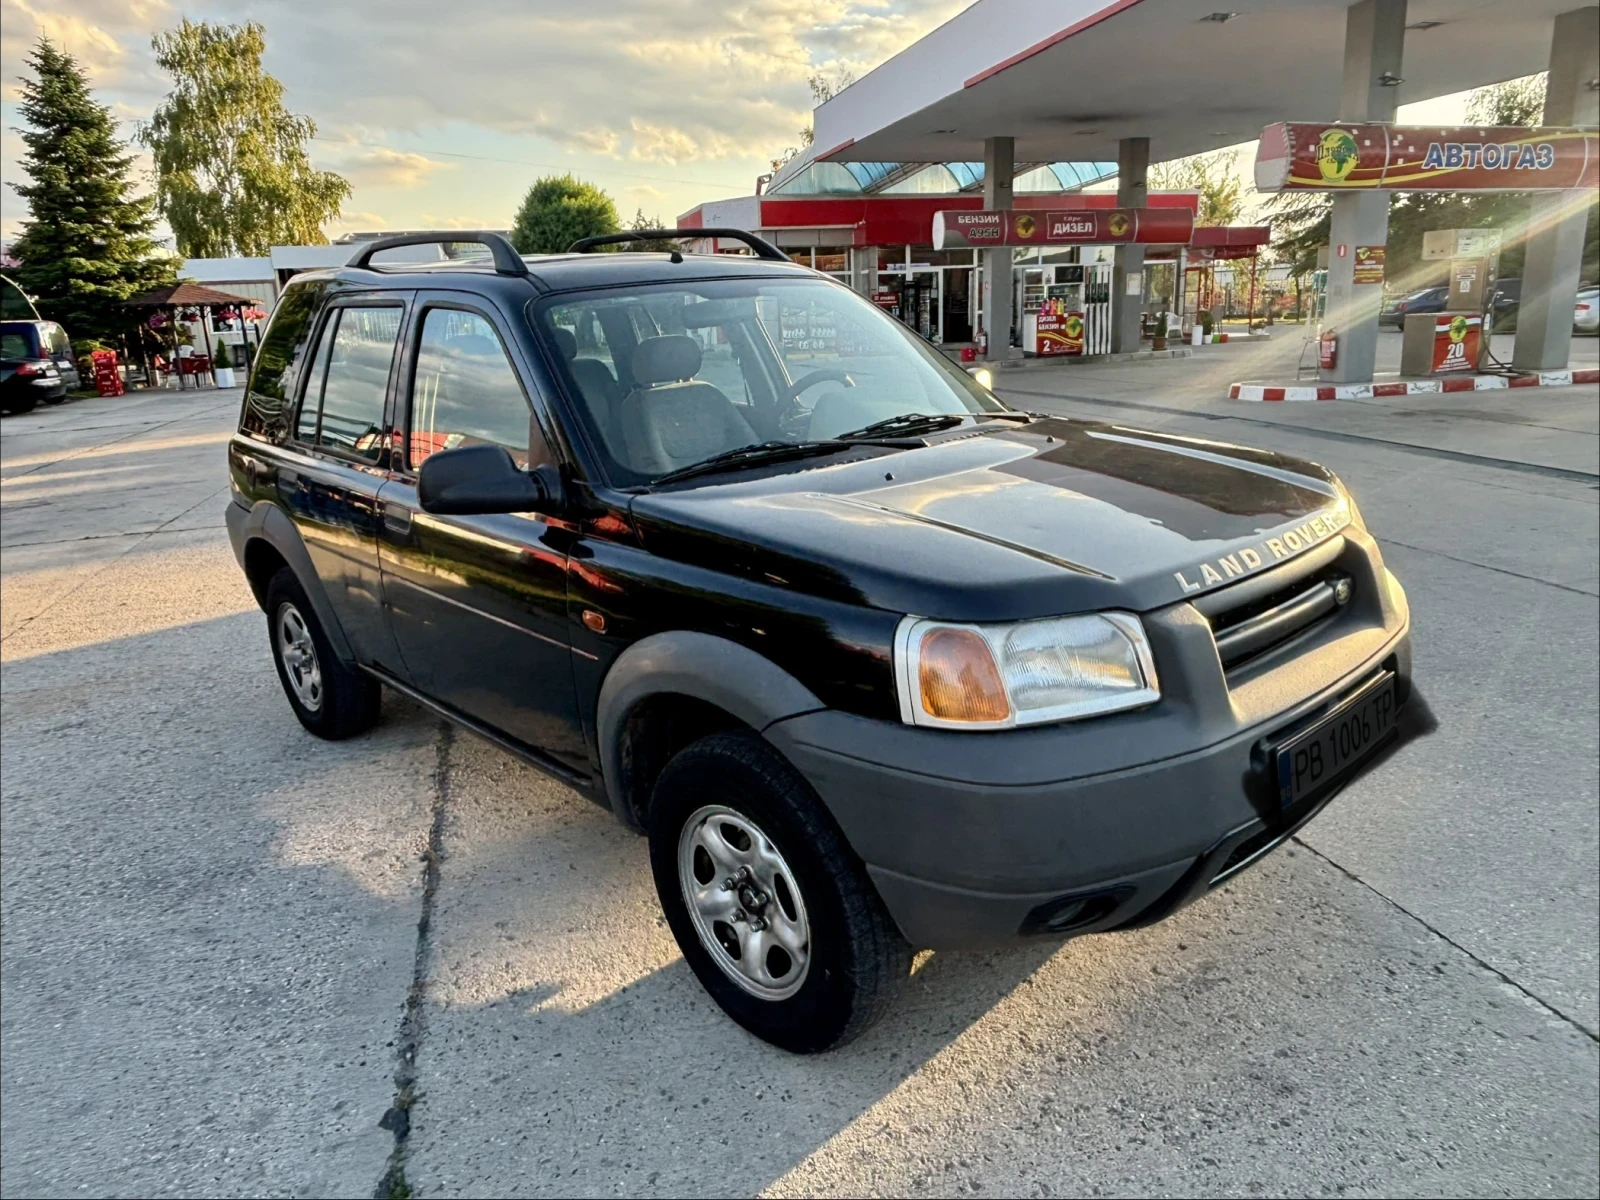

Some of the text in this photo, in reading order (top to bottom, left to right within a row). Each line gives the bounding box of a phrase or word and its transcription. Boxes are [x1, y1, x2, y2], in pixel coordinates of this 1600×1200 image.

[1421, 143, 1554, 170] АВТОГАЗ
[958, 215, 999, 224] БЕНЗИН
[1053, 222, 1093, 235] ДИЗЕЛ
[1043, 339, 1050, 352] 2
[1446, 342, 1465, 359] 20
[1174, 512, 1338, 594] LAND ROVER
[1294, 688, 1392, 793] PB 1006 TP
